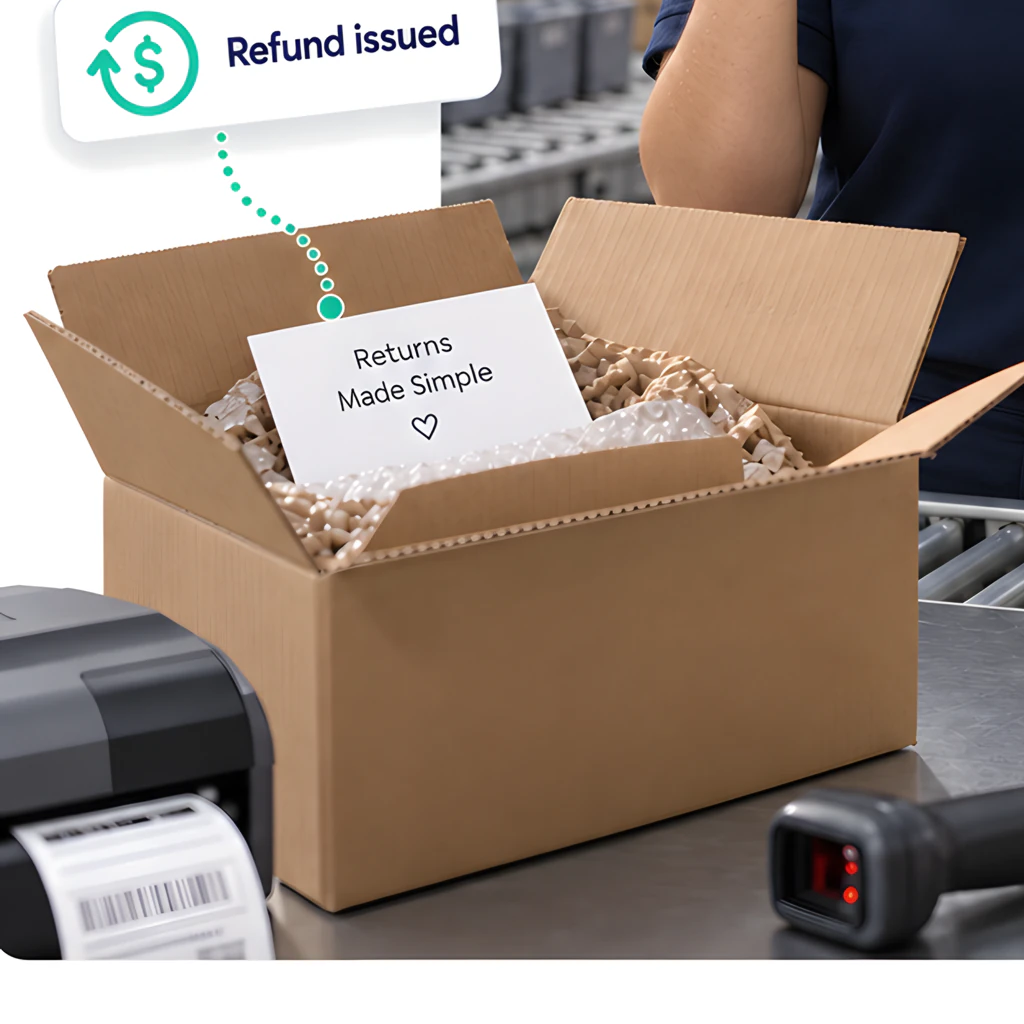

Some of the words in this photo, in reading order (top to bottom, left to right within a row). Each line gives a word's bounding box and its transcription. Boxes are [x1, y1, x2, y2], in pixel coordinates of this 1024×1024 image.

[354, 337, 454, 369] Returns
[337, 380, 406, 412] Made
[411, 362, 494, 396] Simple
